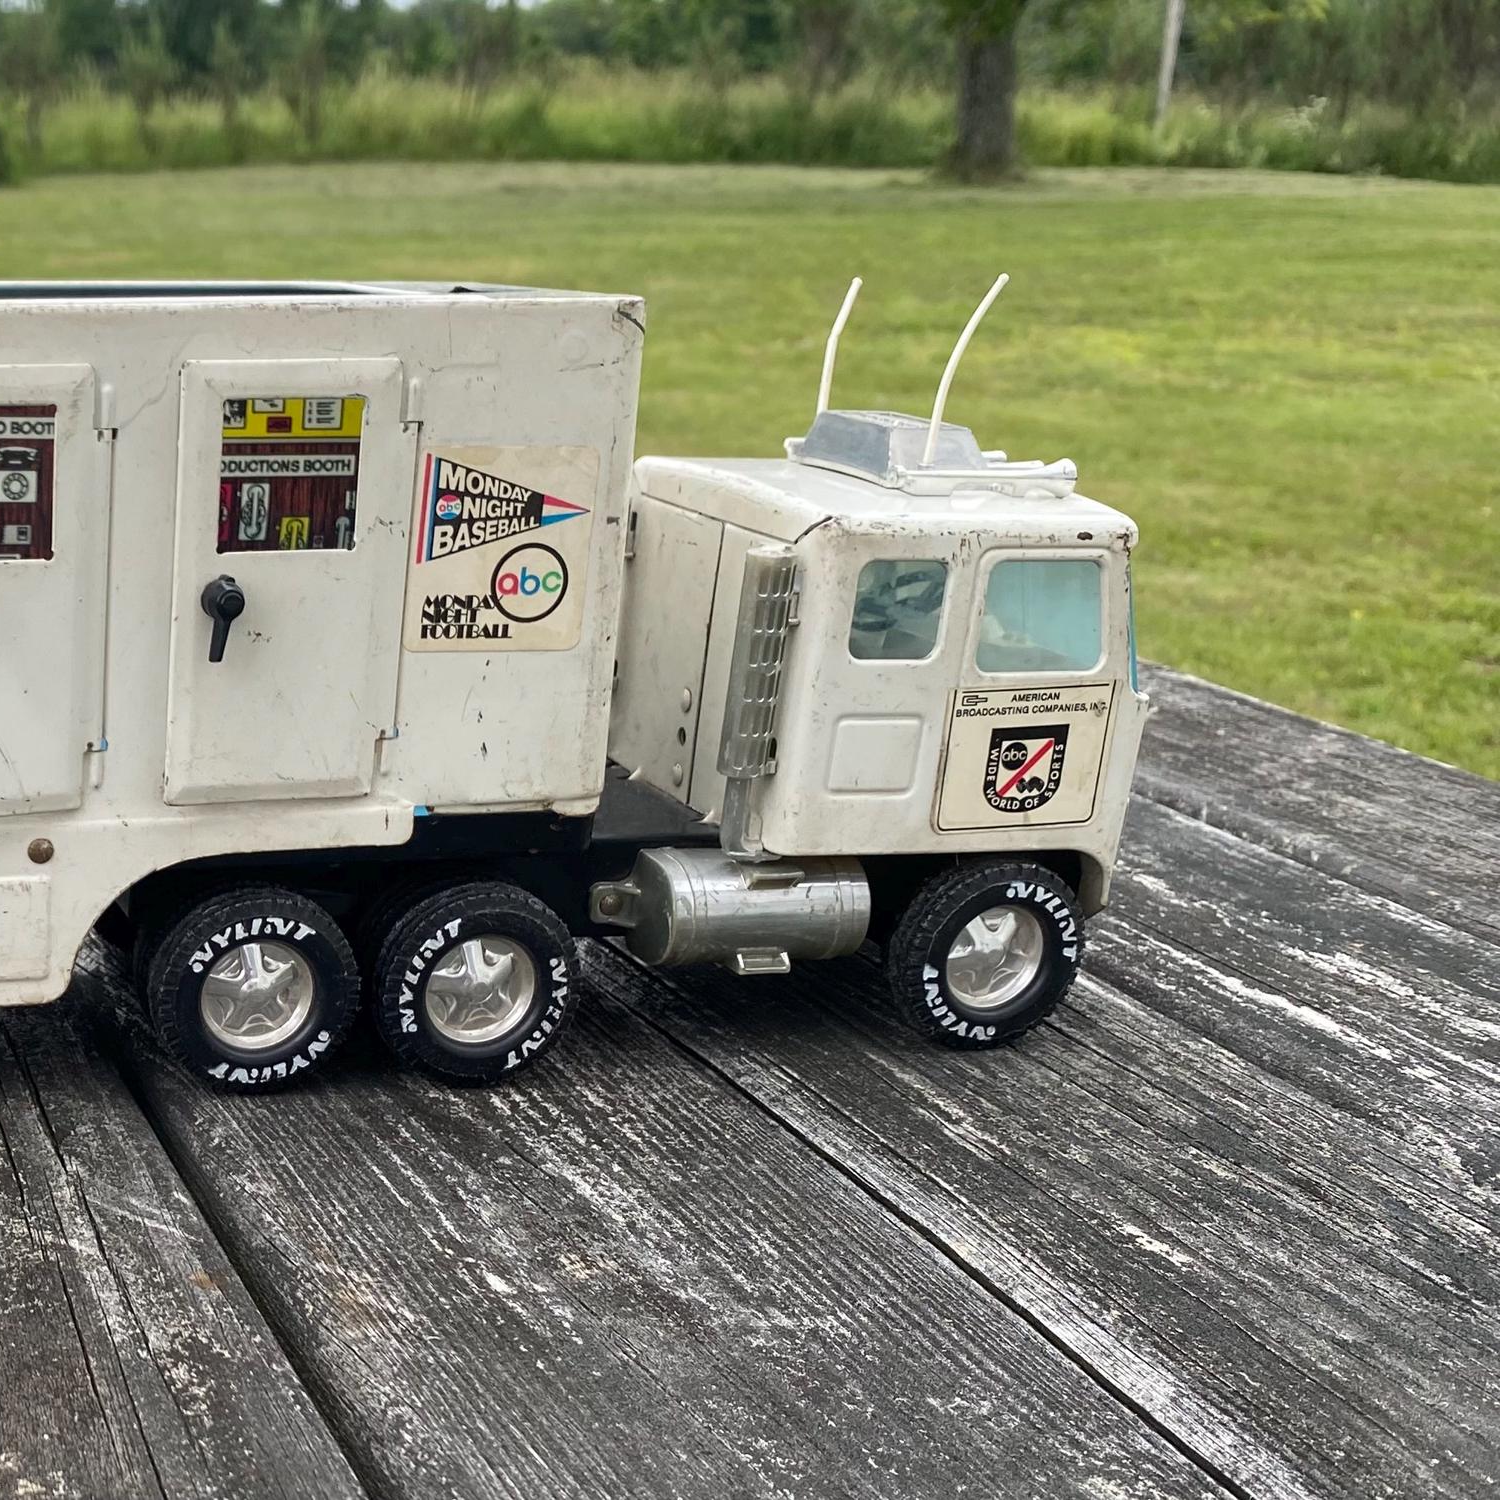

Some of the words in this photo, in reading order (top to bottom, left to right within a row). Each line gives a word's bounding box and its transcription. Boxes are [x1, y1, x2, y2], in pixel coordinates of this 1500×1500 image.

[10, 421, 54, 435] BOOT
[303, 459, 351, 473] BOOTH
[438, 459, 533, 502] MONDAY
[438, 502, 462, 513] abc
[462, 496, 526, 520] NIGHT
[431, 515, 540, 559] BASEBALL
[497, 566, 563, 596] abc
[423, 593, 504, 610] MONDAY
[421, 608, 481, 624] NIGHT
[420, 623, 513, 640] FOOTBALL
[1010, 691, 1061, 703] AMERICAN
[955, 704, 1029, 718] BROADCASTING
[1031, 702, 1088, 714] COMPANIES,
[986, 747, 1000, 782] WIDE
[1001, 748, 1028, 762] abc
[1044, 743, 1064, 798] SPORTS
[985, 786, 1021, 810] WORLD
[1024, 797, 1040, 809] OF
[1006, 880, 1078, 962] NYLINT
[188, 916, 316, 973] NYLINT
[399, 917, 462, 1033] NYLINT
[504, 957, 568, 1070] NYLINT
[922, 963, 997, 1041] NYLINT
[207, 1030, 331, 1084] NYLINT
